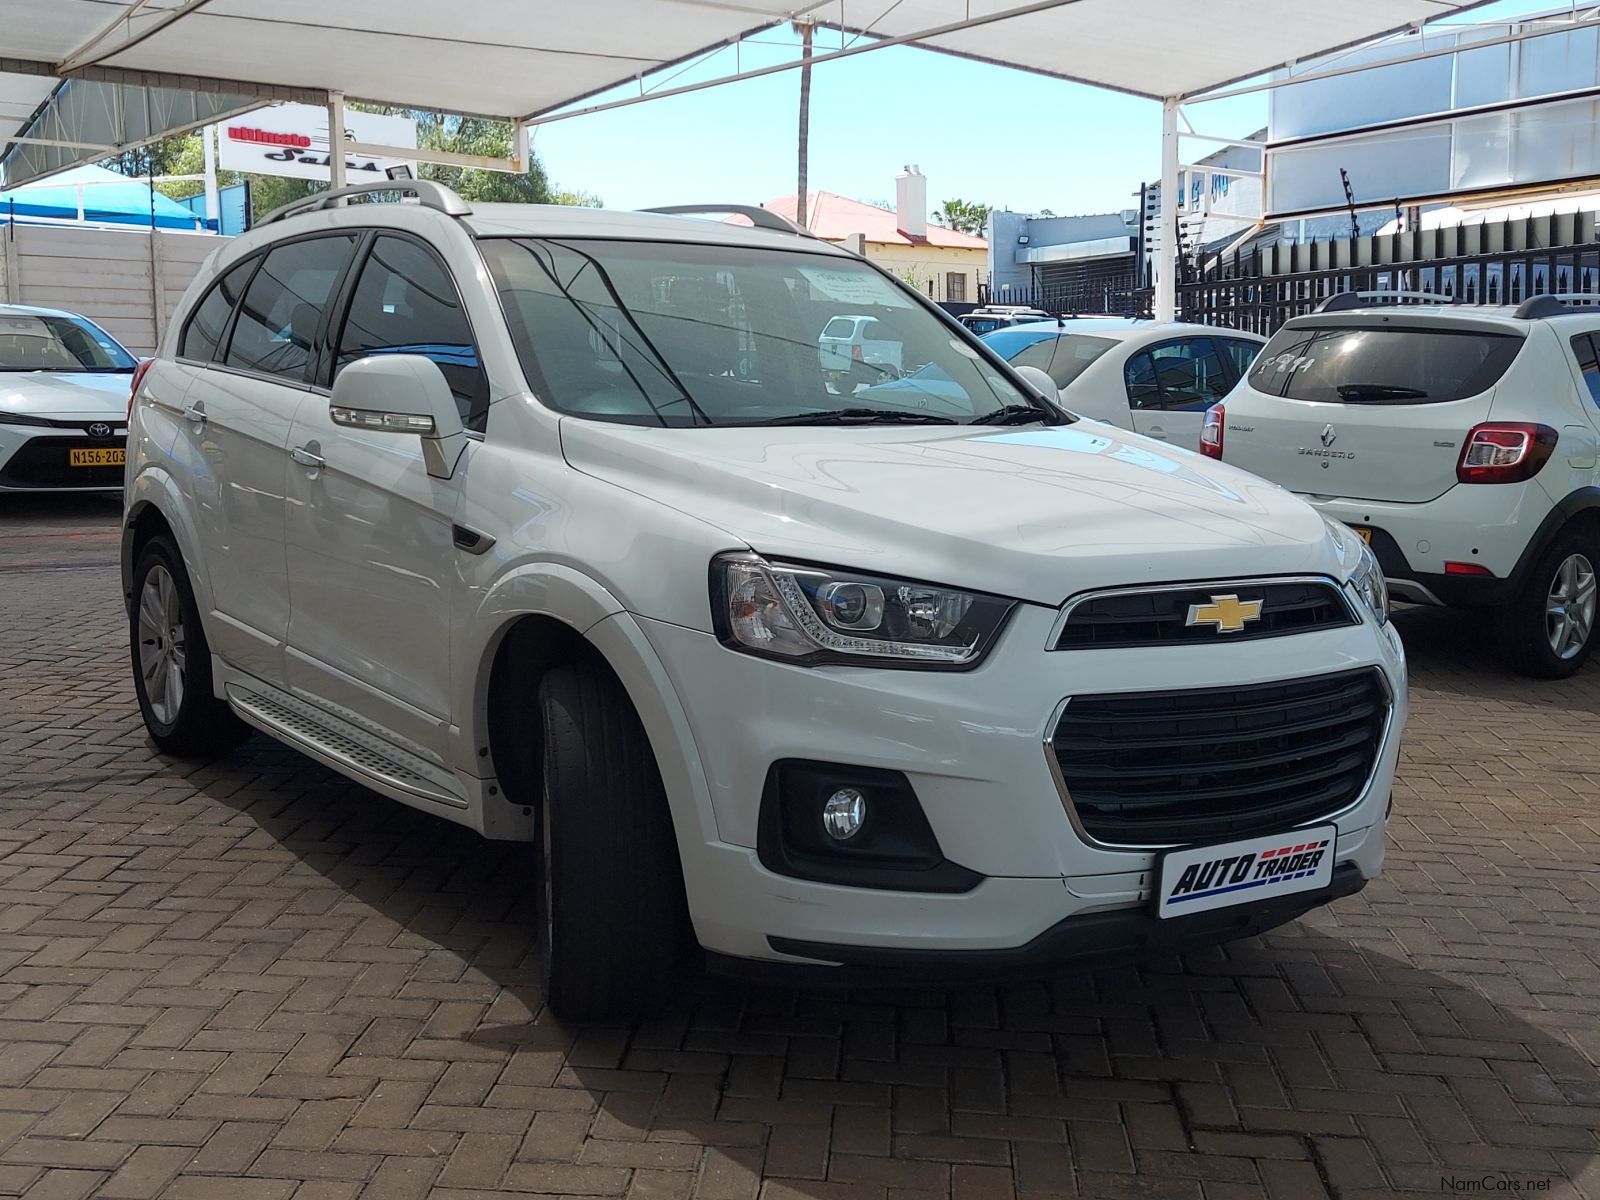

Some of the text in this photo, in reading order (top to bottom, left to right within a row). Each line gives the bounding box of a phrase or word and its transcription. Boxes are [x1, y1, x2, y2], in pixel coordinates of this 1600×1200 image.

[73, 450, 126, 464] N156-203
[1297, 447, 1355, 459] SANDERO
[1170, 850, 1325, 896] AUTO TRADER
